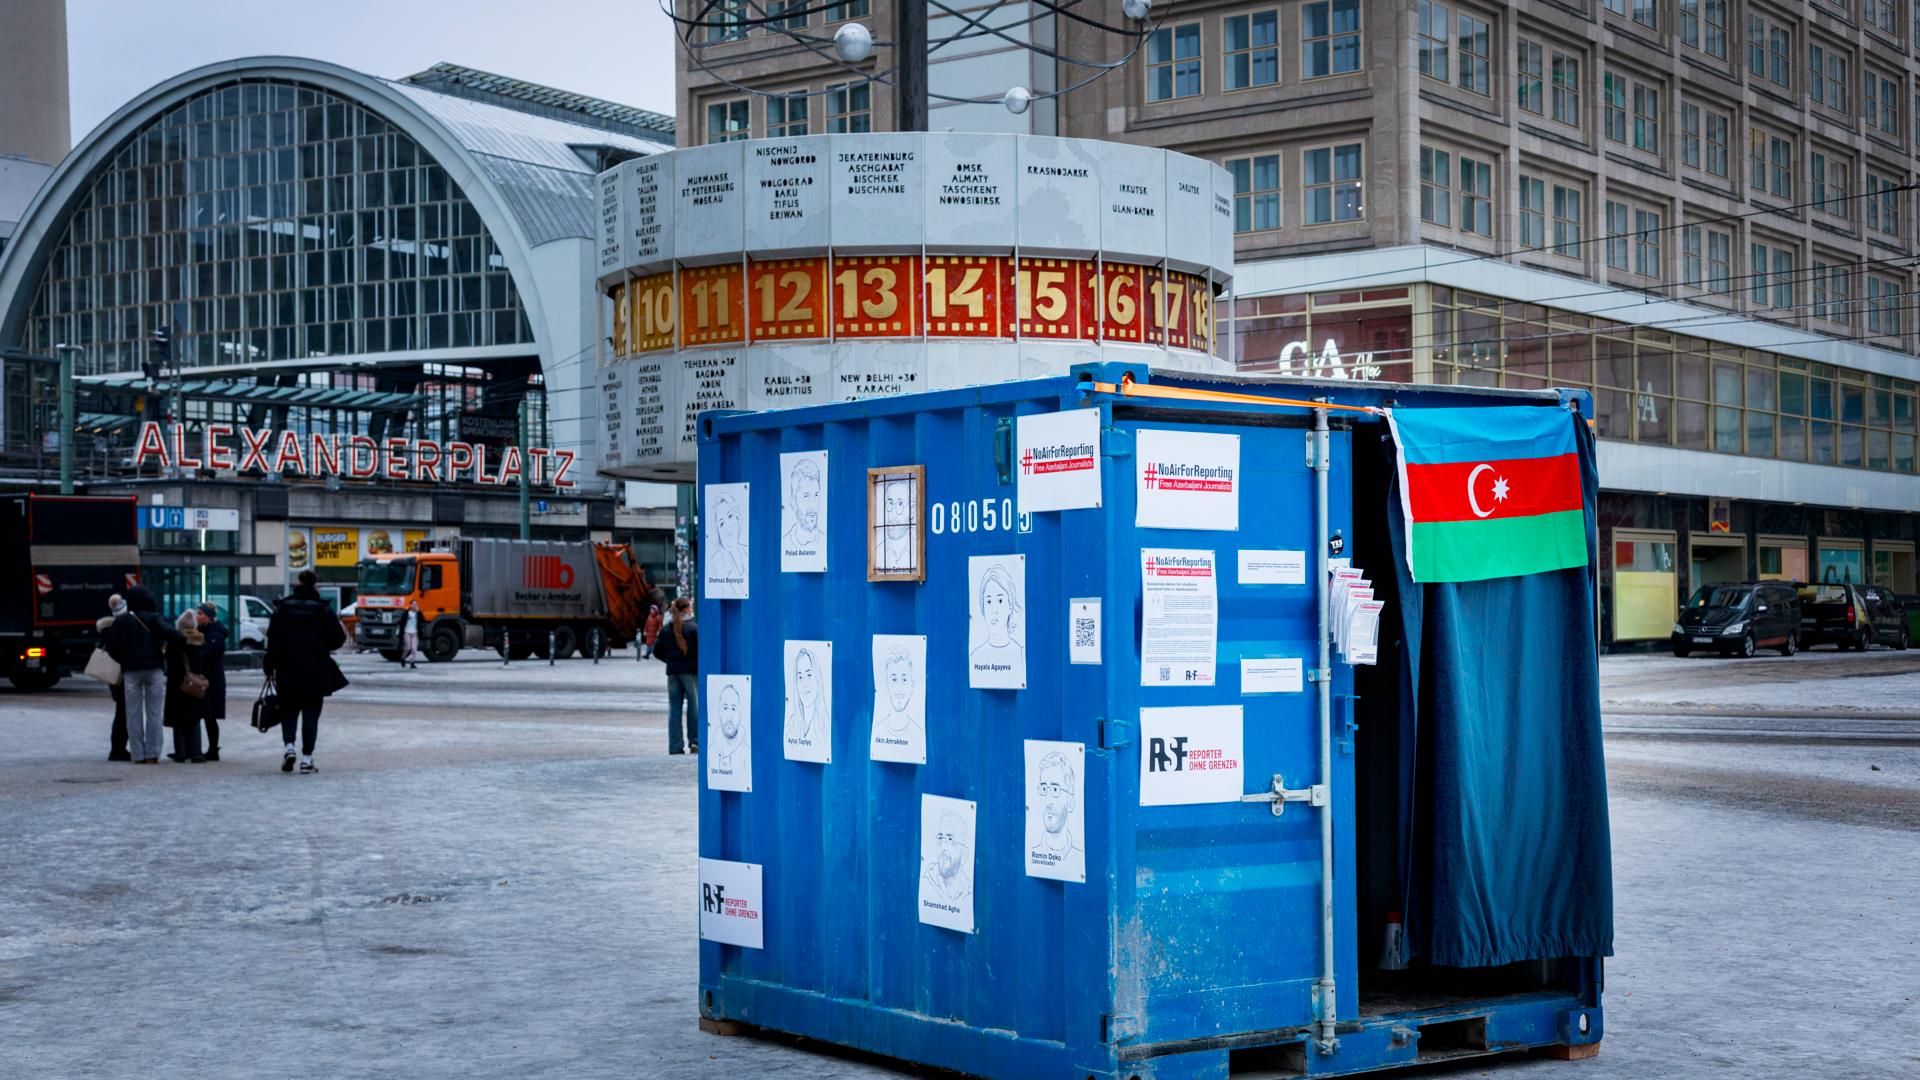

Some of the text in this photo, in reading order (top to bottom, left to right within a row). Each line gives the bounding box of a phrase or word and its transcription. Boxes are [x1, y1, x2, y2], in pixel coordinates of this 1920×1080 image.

[756, 146, 797, 156] NISCHNIJ
[770, 155, 816, 167] NOWGOROD
[839, 152, 914, 162] JEKATERINBURG
[848, 163, 905, 173] ASCHGABAT
[956, 163, 983, 172] OMSK
[1027, 166, 1089, 178] KRASNOJARSK
[687, 172, 729, 186] MURMANSK
[760, 177, 813, 188] WOLGOGRAD
[853, 174, 898, 184] BISCHKEK
[951, 174, 989, 183] ALMATY
[775, 188, 798, 198] BAKU
[848, 185, 905, 195] DUSCHANBE
[942, 185, 997, 195] TASCHKENT
[1119, 183, 1148, 195] IRKUTSK
[693, 195, 723, 206] MOSKAU
[774, 199, 799, 209] TIFLIS
[940, 196, 1000, 206] NOWOSIBIRSK
[770, 209, 803, 219] ERIWAN
[1112, 204, 1155, 217] ULAN-BATOR
[755, 270, 813, 322] 12
[835, 268, 899, 319] 13
[925, 268, 985, 318] 14
[1011, 270, 1068, 321] 15
[691, 277, 729, 328] 11
[1088, 275, 1136, 325] 16
[1150, 280, 1184, 330] 17
[641, 285, 675, 337] 10
[639, 364, 661, 374] ANKARA
[684, 359, 718, 369] TEHERAN
[696, 368, 725, 379] BAGDAD
[840, 374, 860, 383] NEW
[866, 373, 893, 382] DELHI
[700, 380, 721, 389] ADEN
[764, 376, 792, 386] KABUL
[765, 385, 812, 396] MAURITIUS
[856, 384, 901, 393] KARACHI
[696, 390, 724, 400] SANAA
[686, 400, 735, 411] ADDIS ABEBA
[136, 420, 577, 488] ALEXANDERPLATZ
[1023, 443, 1094, 475] #NoAirForReporting
[1144, 462, 1233, 489] #NoAirForReporting
[1159, 480, 1172, 488] Free
[151, 507, 165, 527] U
[1149, 736, 1222, 772] RSF REPORTER
[1189, 759, 1238, 770] OHNE GRENZEN
[702, 882, 748, 914] RSF REPORTER
[725, 907, 758, 920] OHNE GRENZEN
